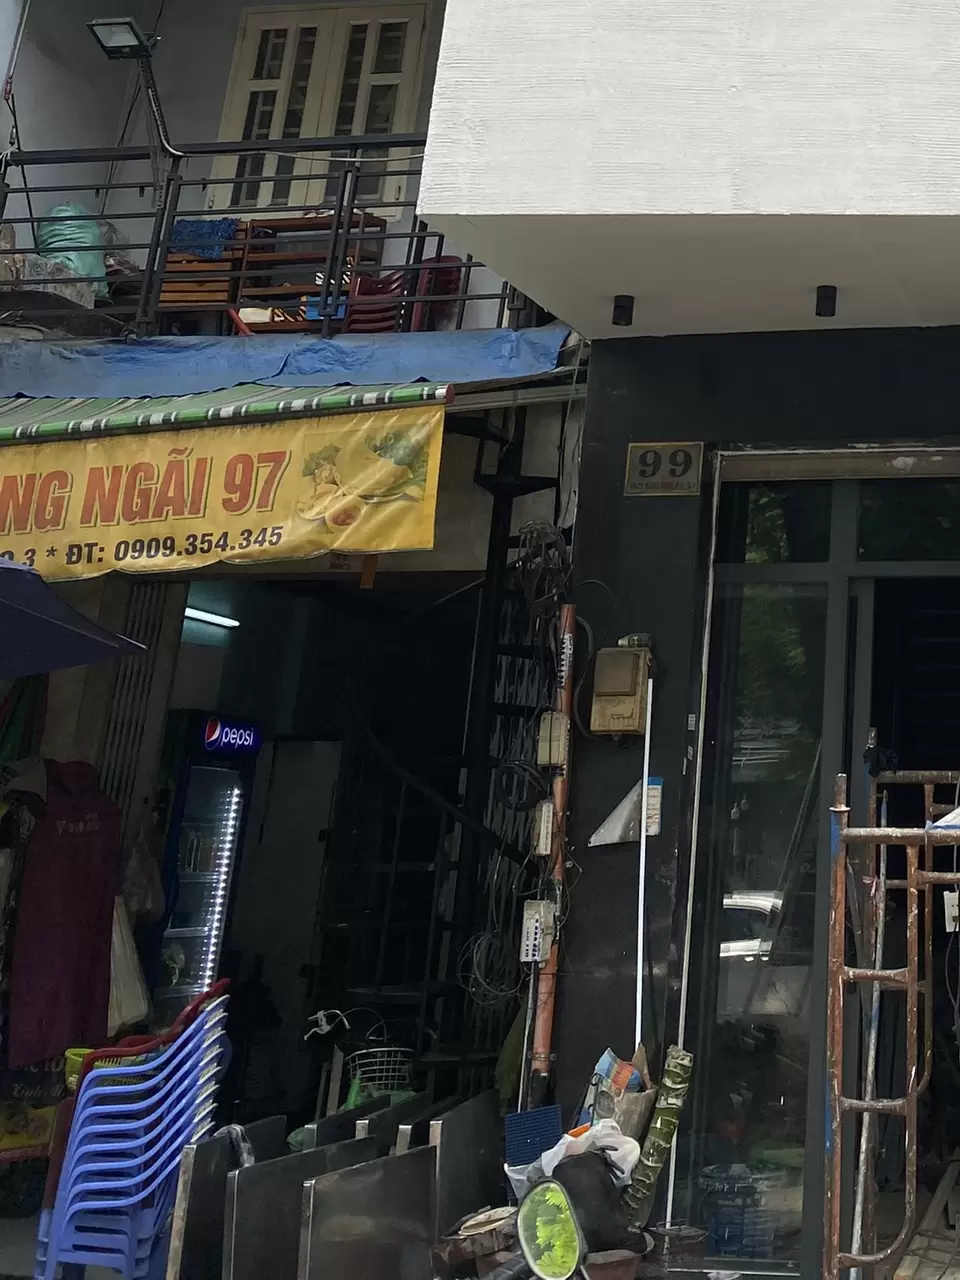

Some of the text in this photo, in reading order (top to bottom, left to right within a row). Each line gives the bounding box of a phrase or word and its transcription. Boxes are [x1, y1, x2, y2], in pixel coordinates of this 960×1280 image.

[638, 449, 692, 477] 99
[80, 447, 212, 526] NGÃI
[222, 449, 291, 516] 97
[65, 542, 105, 565] ĐT:
[114, 526, 284, 562] 0909.354.345
[220, 727, 254, 749] pepsi
